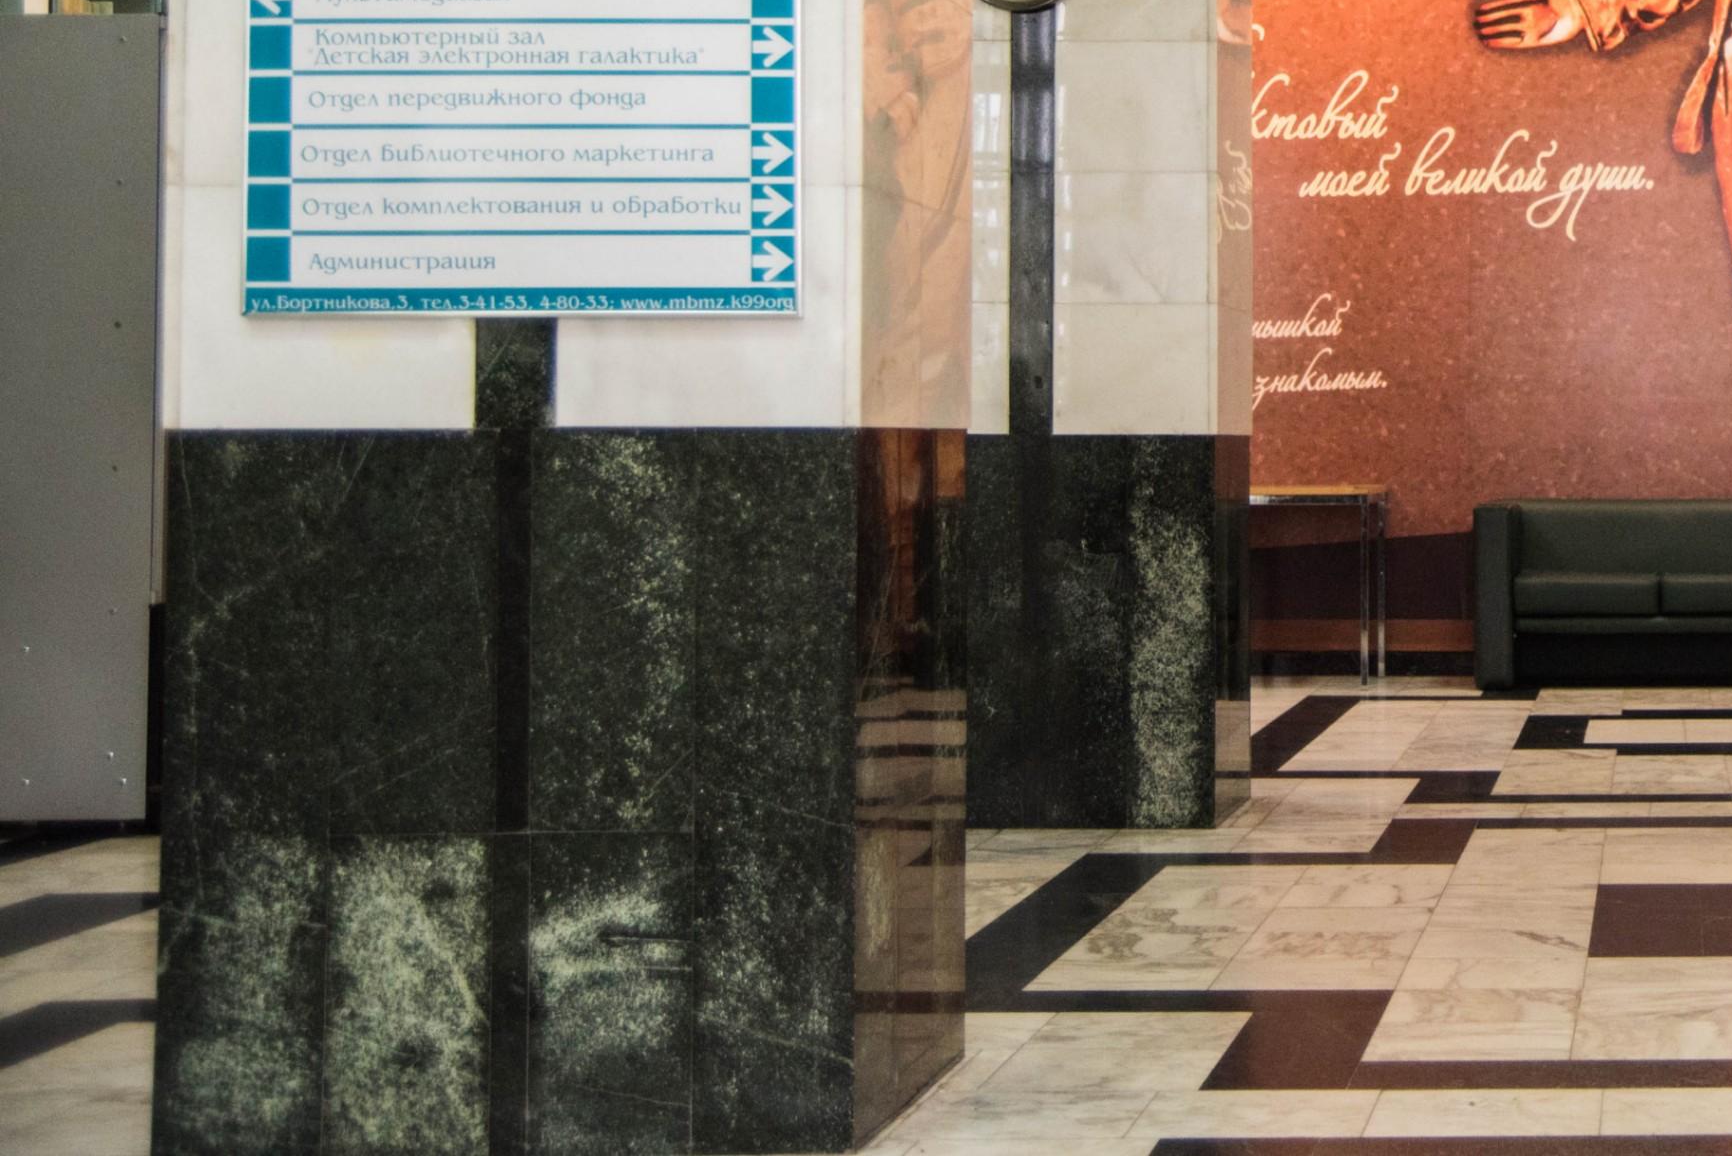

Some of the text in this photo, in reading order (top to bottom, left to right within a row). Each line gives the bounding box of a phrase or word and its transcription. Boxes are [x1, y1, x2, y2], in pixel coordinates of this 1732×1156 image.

[315, 28, 545, 48] Компьютерный зал
[417, 50, 569, 67] электронная
[308, 90, 646, 113] Отдел передвижного фонда
[300, 145, 715, 167] Отдел библиотечного маркетинга
[1299, 142, 1401, 198] моей
[1405, 127, 1558, 197] великой
[1526, 162, 1656, 242] души.
[302, 197, 741, 219] Отдел комплектования и обработки
[309, 252, 496, 274] Администрация
[1252, 347, 1388, 411] знакомым.
